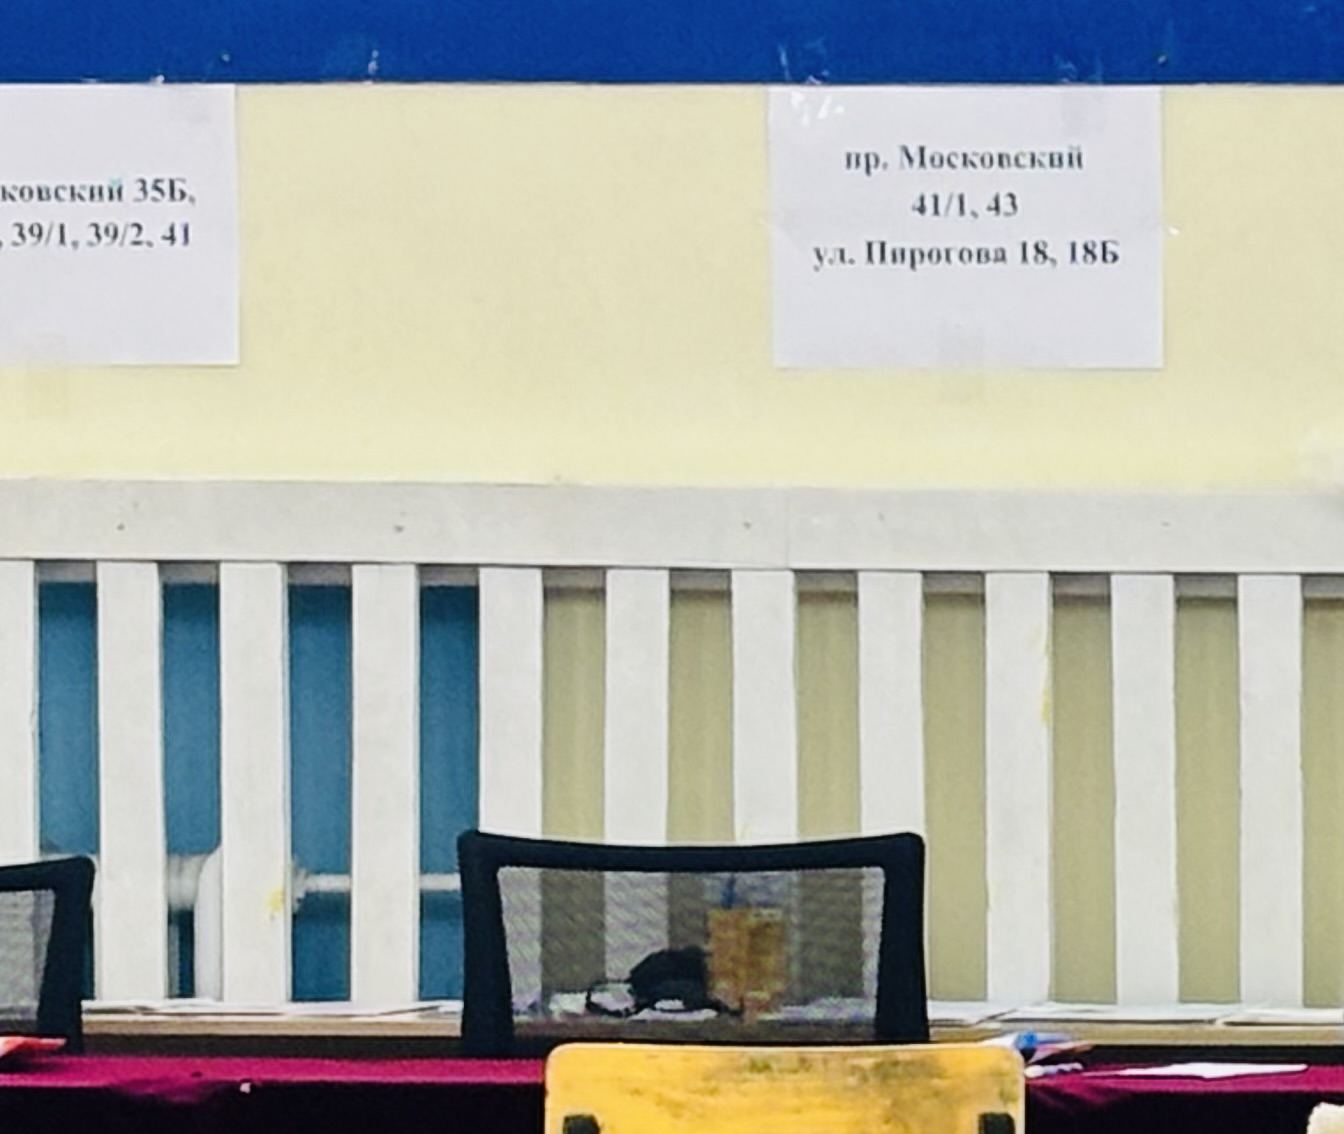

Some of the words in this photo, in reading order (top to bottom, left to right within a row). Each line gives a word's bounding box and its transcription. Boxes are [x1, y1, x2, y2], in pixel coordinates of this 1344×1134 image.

[845, 151, 888, 177] пр.
[899, 144, 1084, 170] Московский
[133, 178, 196, 205] 35Б,
[911, 192, 979, 219] 41/1,
[985, 192, 1019, 217] 43
[11, 222, 79, 250] 39/1,
[86, 222, 154, 248] 39/2,
[160, 222, 190, 247] 41
[813, 246, 856, 273] ул.
[865, 240, 1007, 272] Пирогова
[1020, 240, 1058, 267] 18,
[1069, 240, 1120, 265] 18Б
